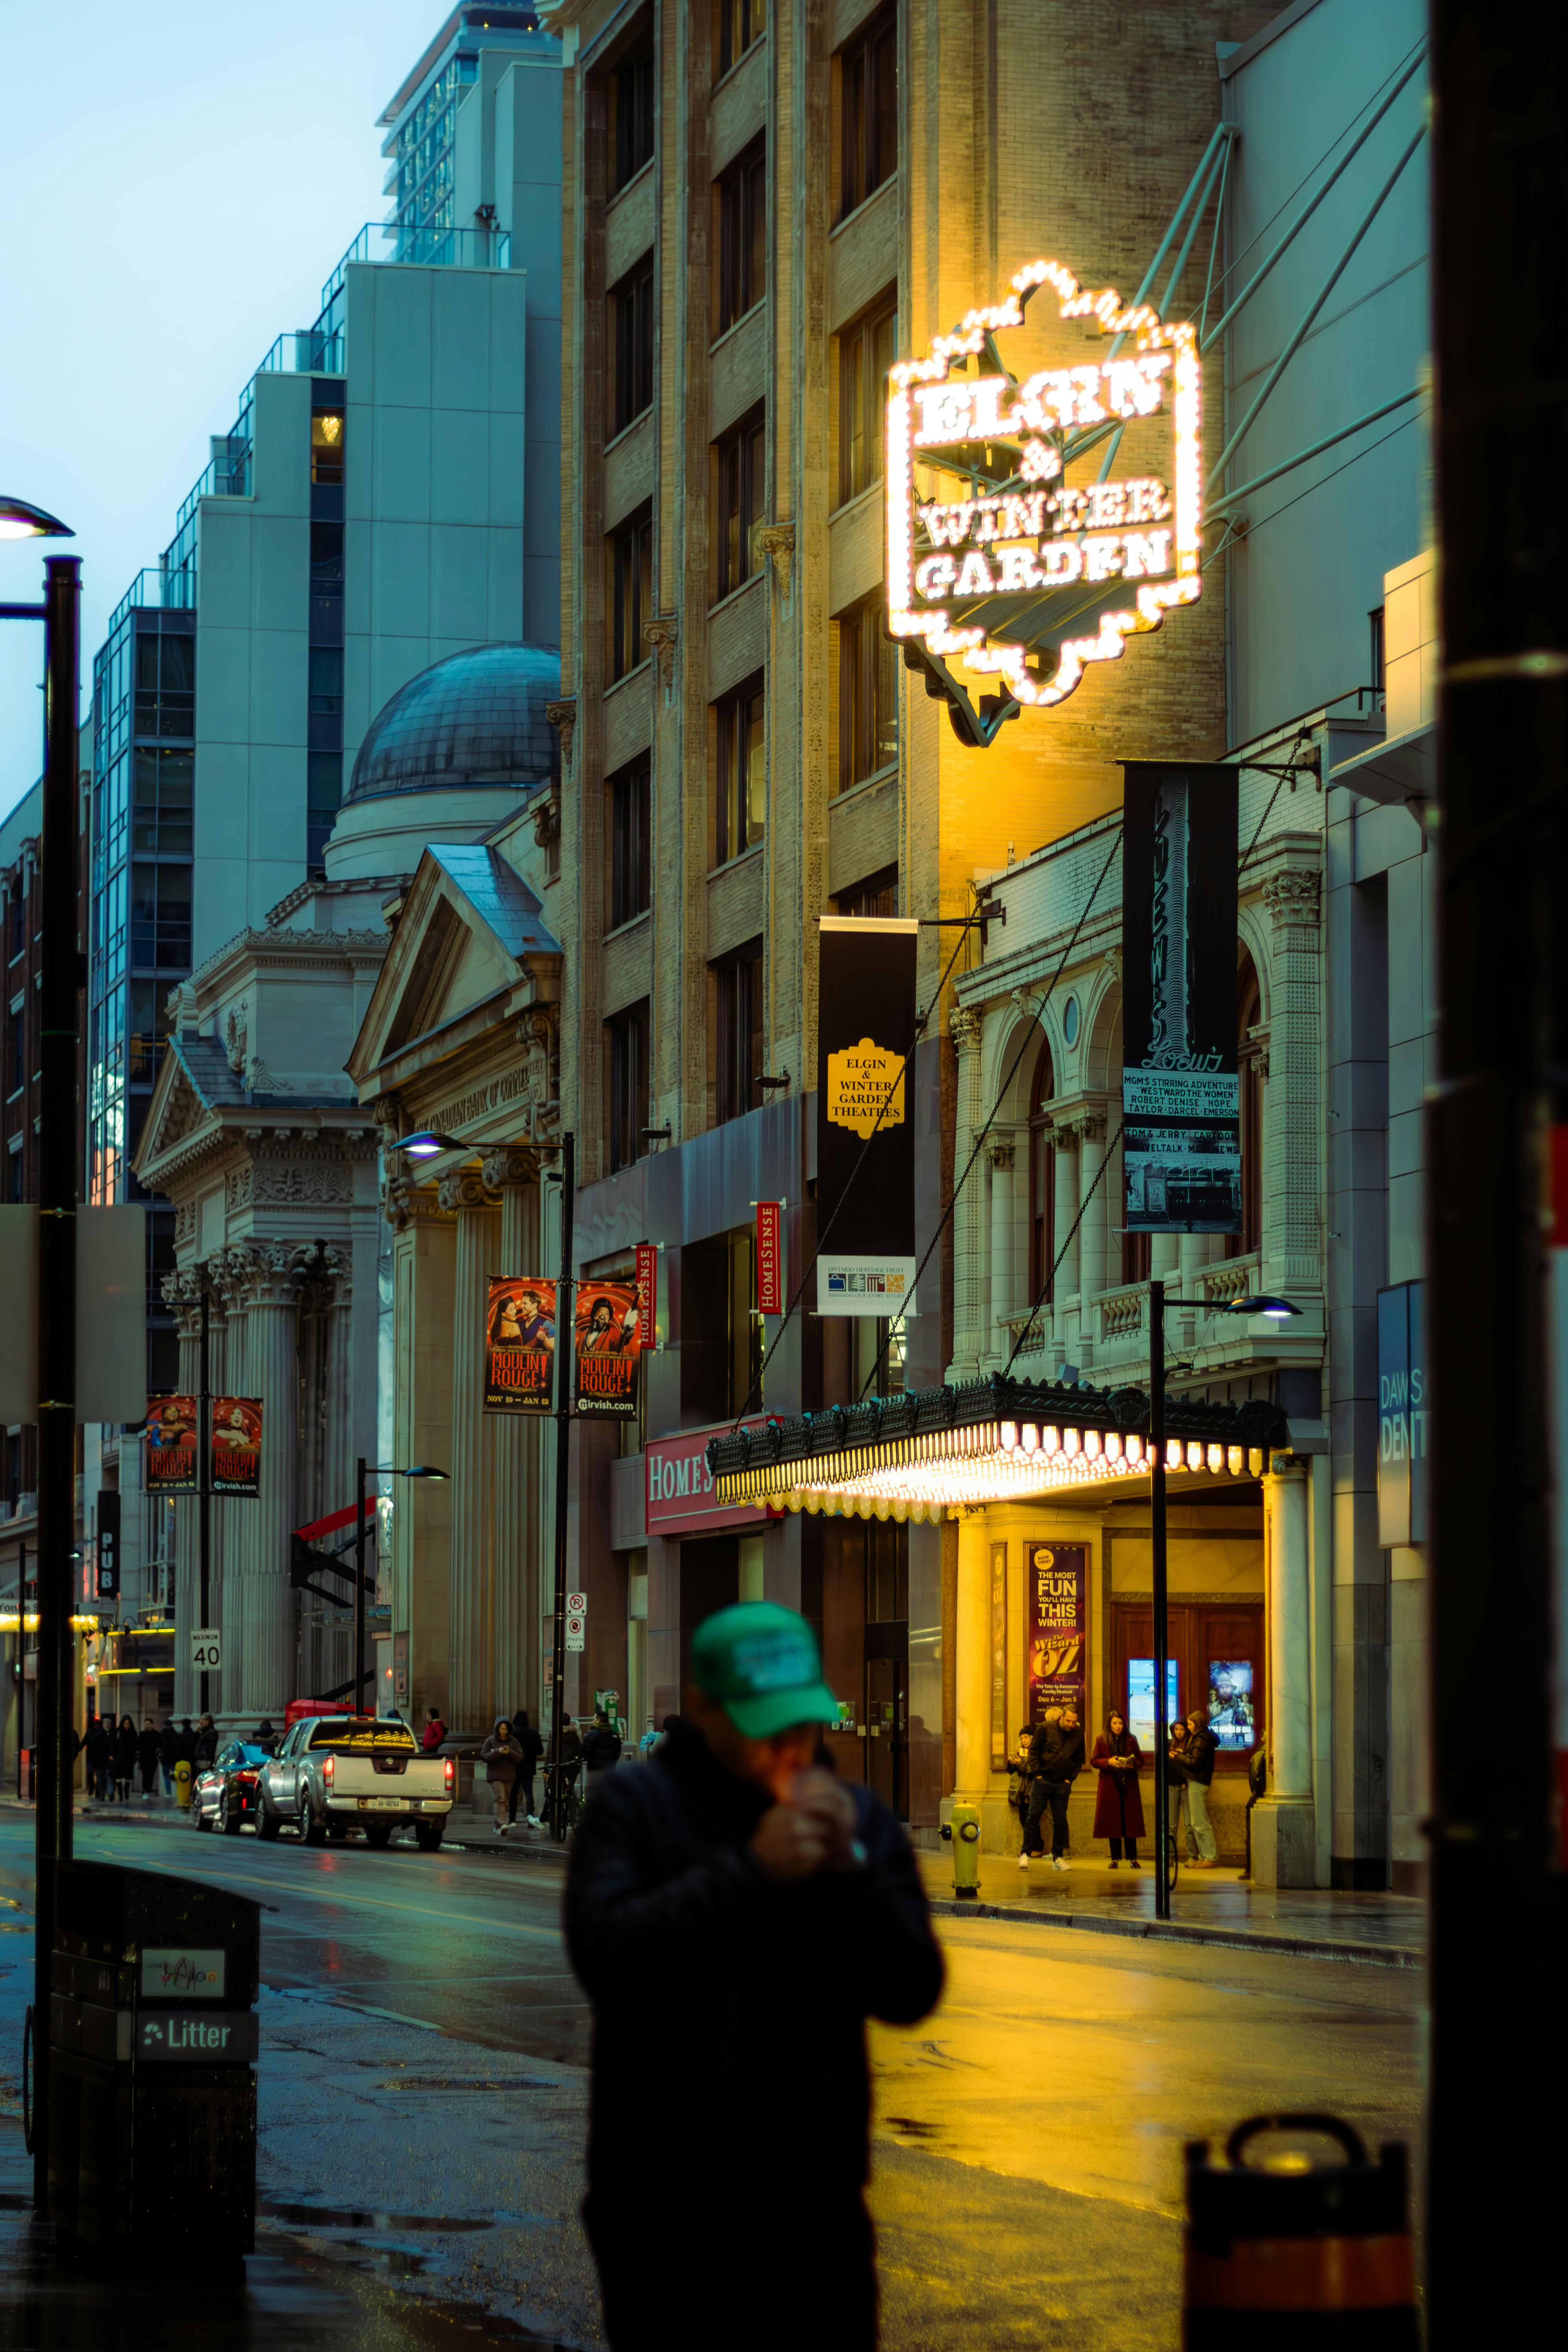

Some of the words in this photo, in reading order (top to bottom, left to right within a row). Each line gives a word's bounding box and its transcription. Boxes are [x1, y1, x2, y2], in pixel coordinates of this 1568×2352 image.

[914, 354, 1171, 444] ELGIN
[1021, 438, 1062, 483] &
[920, 479, 1173, 547] WINTER
[915, 529, 1172, 601] GARDEN
[847, 1059, 886, 1069] ELGIN
[862, 1070, 871, 1079] &
[840, 1081, 893, 1091] WINTER
[1152, 1078, 1189, 1088] STIRRING
[1191, 1081, 1238, 1090] ADVENTURE
[839, 1094, 892, 1104] GARDEN
[1131, 1095, 1165, 1105] ROBERT
[1168, 1098, 1199, 1106] DENISE
[1208, 1099, 1230, 1108] HOPE
[1187, 1089, 1202, 1098] THE
[832, 1107, 900, 1117] THEATRES
[1129, 1104, 1162, 1114] TAYLOR
[1168, 1107, 1200, 1116] DARCEL
[1204, 1108, 1239, 1117] EMERSON
[1126, 1129, 1145, 1137] TOM
[1147, 1129, 1153, 1138] &
[1156, 1130, 1186, 1139] JERRY
[492, 1352, 539, 1370] MOULIN
[581, 1357, 625, 1375] MOULIN
[1381, 1368, 1427, 1409] DAWS
[1382, 1411, 1427, 1463] DENT
[101, 1532, 113, 1589] PUB
[1038, 1580, 1077, 1596] FUN
[1038, 1604, 1076, 1617] THIS
[1038, 1619, 1076, 1627] WINTER!
[1035, 1634, 1080, 1651] Wizard
[194, 1646, 219, 1665] 40
[1033, 1646, 1080, 1677] OZ
[169, 2020, 231, 2047] Litter
